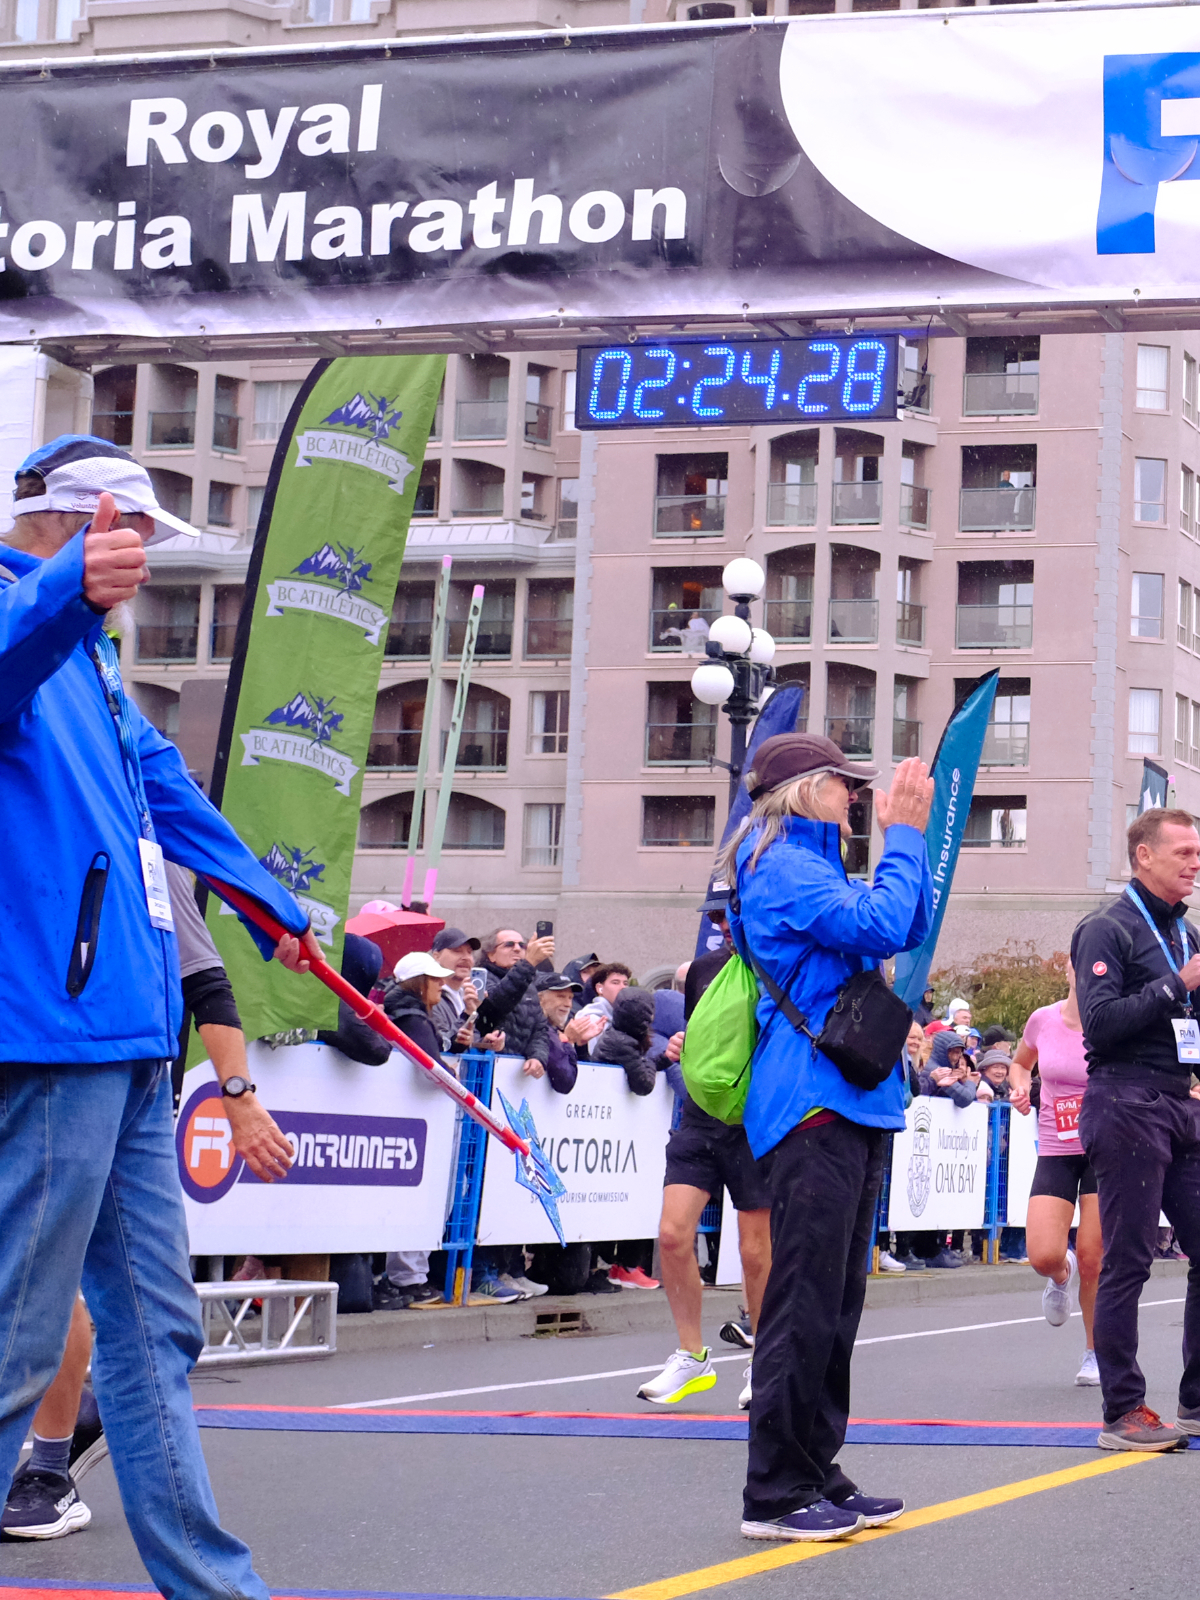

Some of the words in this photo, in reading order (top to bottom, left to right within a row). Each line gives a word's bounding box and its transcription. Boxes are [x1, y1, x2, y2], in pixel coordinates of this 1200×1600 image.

[126, 84, 383, 180] Royal
[229, 178, 688, 265] Marathon
[588, 340, 887, 419] 02:24.28
[306, 437, 326, 452] BC
[329, 439, 401, 475] ATHLETICS
[71, 502, 100, 511] Voluntee
[277, 586, 297, 602] BC
[300, 589, 377, 626] ATHLETICS
[254, 736, 268, 751] BC
[271, 739, 346, 776] ATHLETICS
[933, 767, 961, 883] Insurance
[566, 1104, 612, 1119] GREATER
[1057, 1101, 1077, 1111] RVM
[284, 1132, 418, 1170] ONTRUNNERS
[938, 1128, 970, 1160] Municipality
[972, 1129, 980, 1151] of
[588, 1191, 629, 1203] COMMISSION
[936, 1163, 957, 1194] OAK
[958, 1163, 978, 1194] BAY
